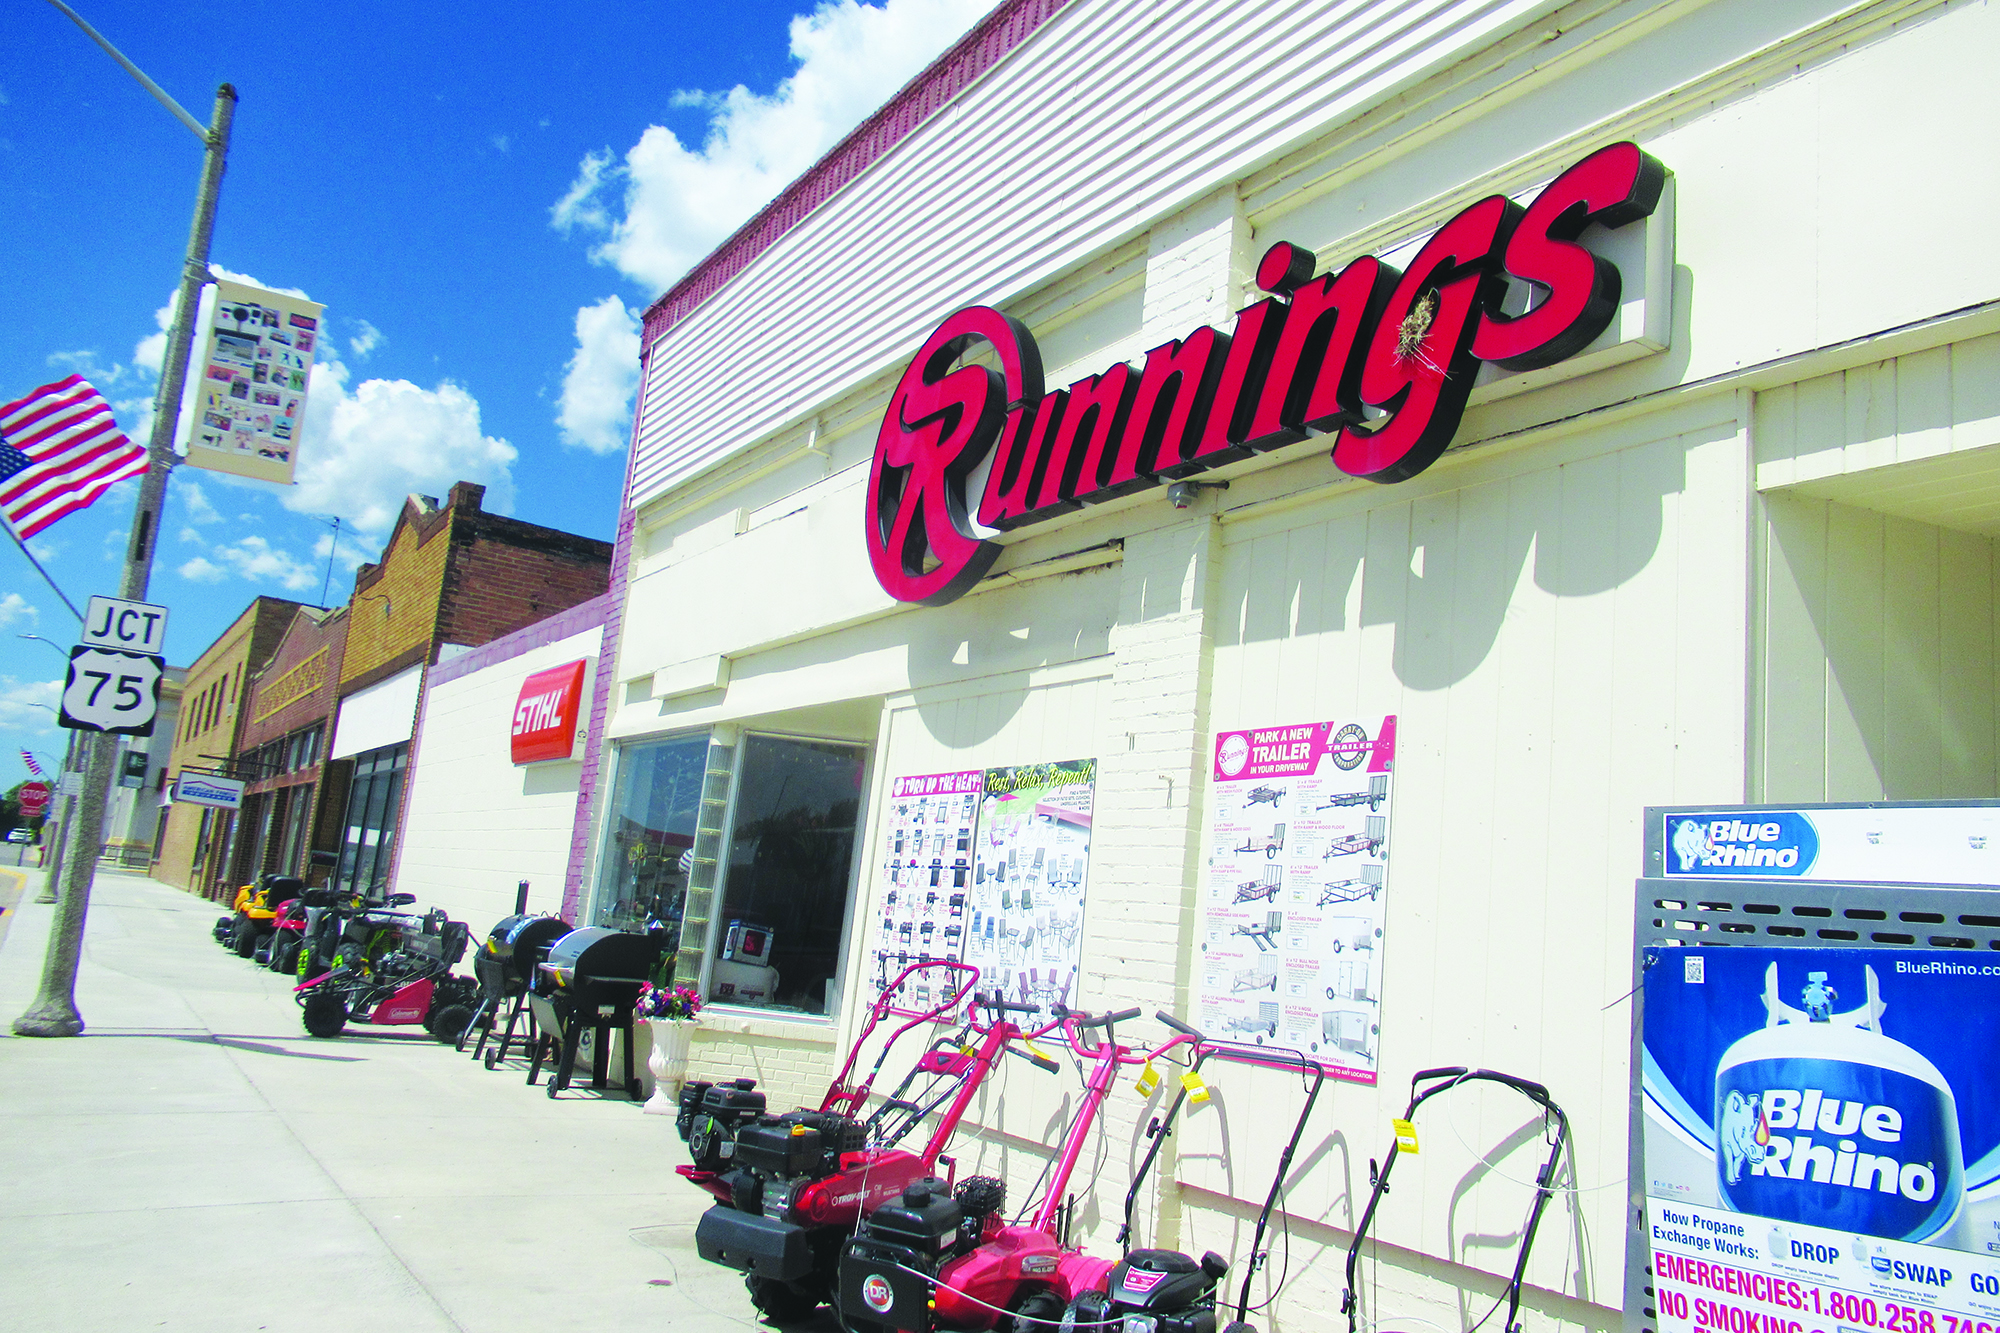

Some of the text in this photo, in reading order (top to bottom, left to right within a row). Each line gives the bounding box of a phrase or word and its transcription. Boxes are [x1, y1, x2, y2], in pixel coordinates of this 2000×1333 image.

[866, 140, 1666, 606] Runnings
[91, 606, 161, 644] JCT
[83, 670, 143, 712] 75
[512, 688, 563, 736] STIHL
[1253, 726, 1314, 745] PARK A NEW
[1327, 742, 1373, 752] TRAILER
[1252, 742, 1311, 764] TRAILER
[987, 762, 1094, 794] Rest, Relax, Repeat!
[1250, 762, 1310, 775] IN YOUR DRIVEWAY
[20, 789, 49, 800] STOP
[904, 773, 982, 795] TURN UP THE HEAT!
[1708, 819, 1780, 843] Blue
[1701, 843, 1799, 868] Rhino
[1762, 1088, 1903, 1143] Blue
[1750, 1136, 1936, 1202] Rhino
[838, 1189, 872, 1204] TROY-BLT
[1662, 1208, 1745, 1240] How Propane
[1653, 1225, 1759, 1260] Exchange Works:
[1790, 1240, 1840, 1265] DROP
[1893, 1259, 1953, 1287] SWAP
[1970, 1272, 1999, 1296] GO
[869, 1285, 888, 1300] DR
[1658, 1287, 1689, 1320] NO
